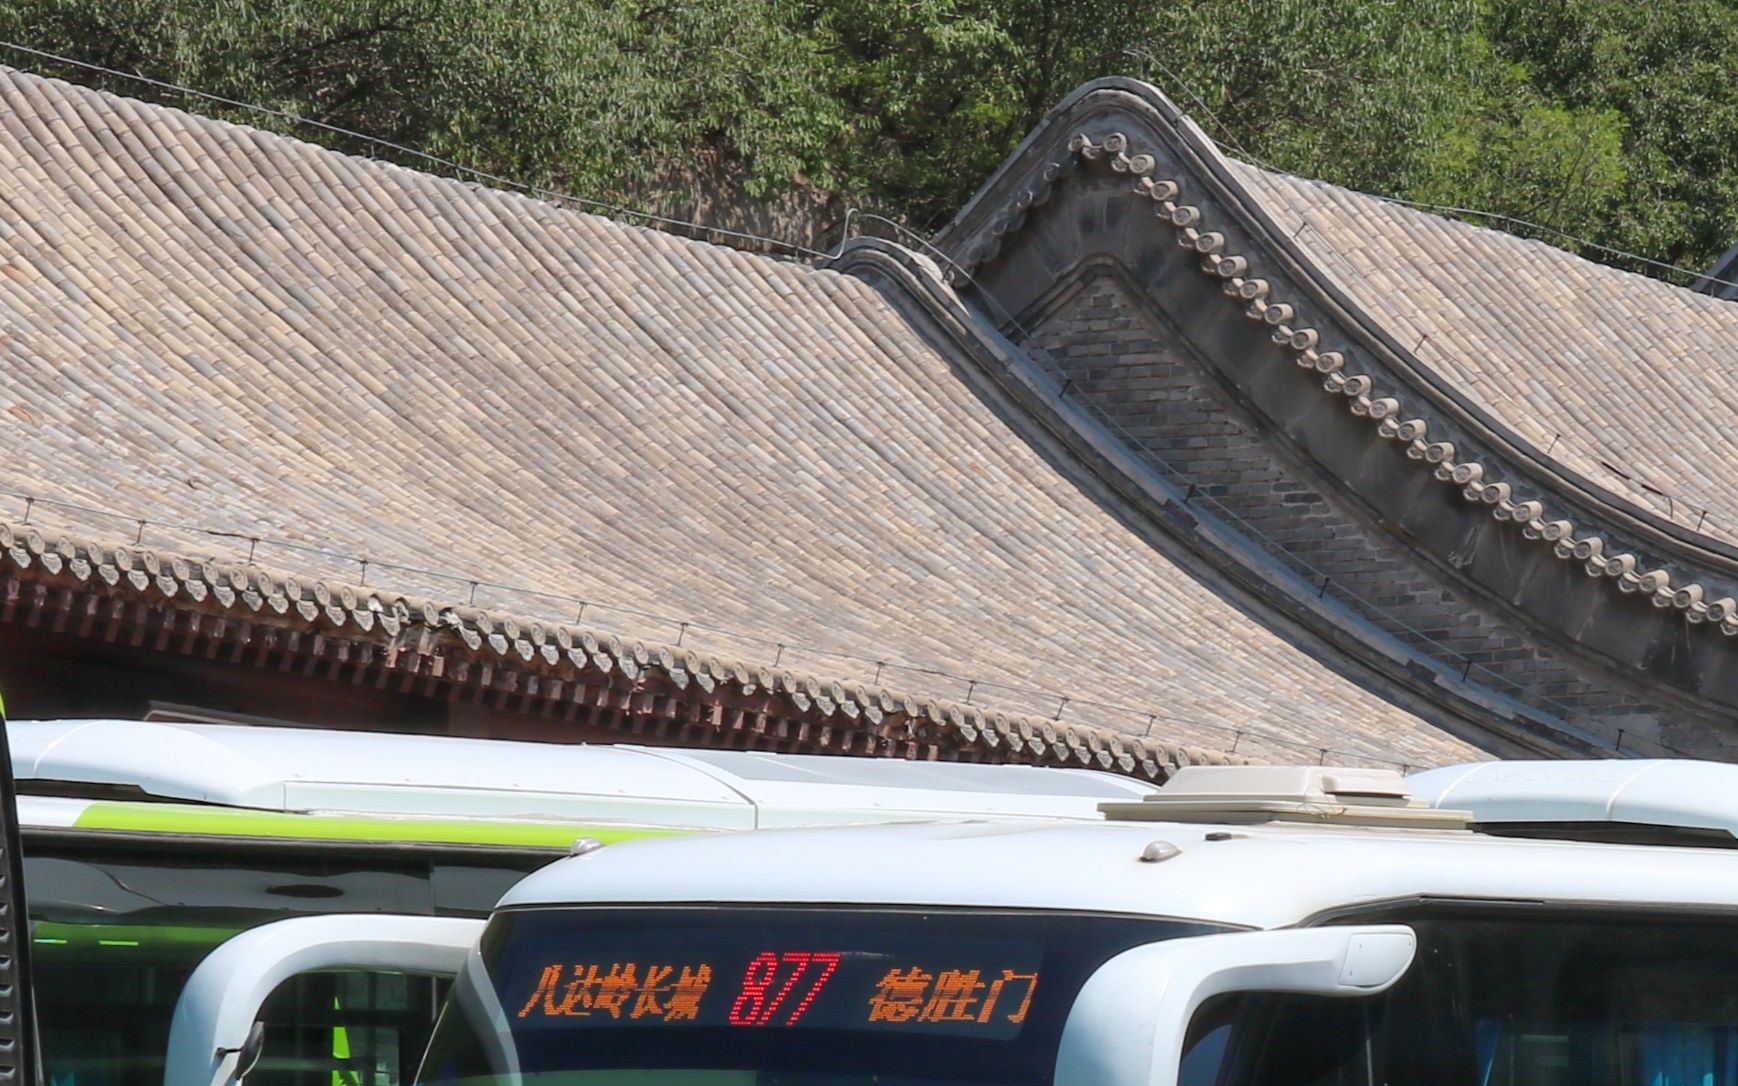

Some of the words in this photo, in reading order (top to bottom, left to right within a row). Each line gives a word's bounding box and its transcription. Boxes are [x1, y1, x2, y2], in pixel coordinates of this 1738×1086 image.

[518, 963, 712, 1022] 八达岭长城
[728, 951, 842, 1026] 877
[868, 966, 1039, 1024] 德胜门
